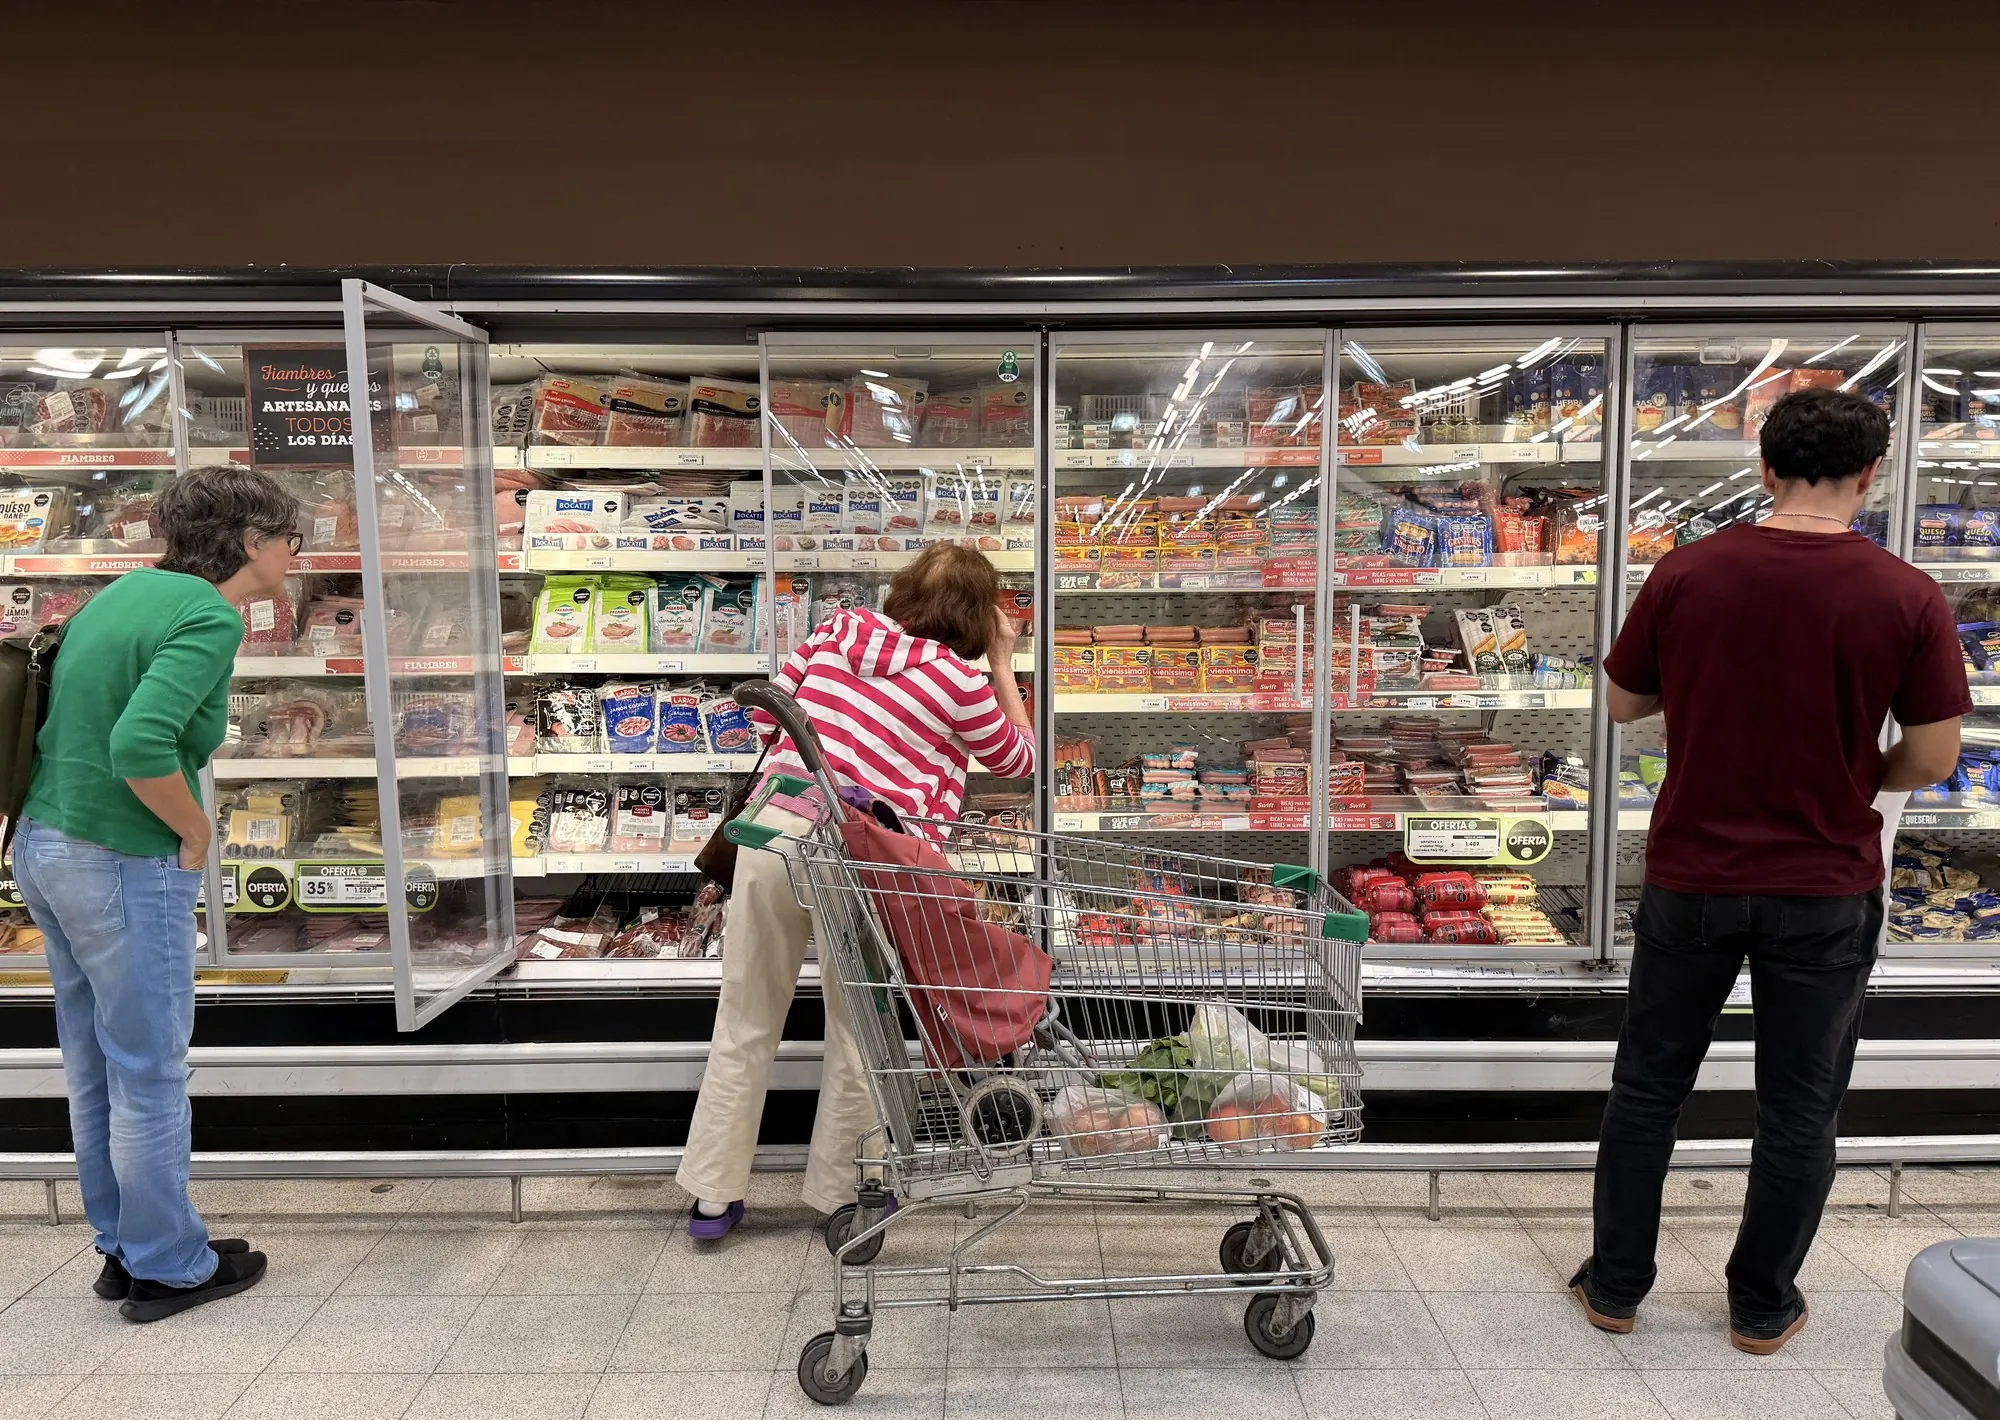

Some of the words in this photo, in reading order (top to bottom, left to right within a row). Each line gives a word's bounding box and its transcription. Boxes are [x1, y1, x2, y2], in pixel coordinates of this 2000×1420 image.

[261, 364, 336, 381] Fiambres
[305, 382, 318, 399] y
[321, 381, 382, 399] ques
[288, 435, 317, 446] LOS
[60, 455, 115, 463] FIAMBRES
[559, 502, 590, 511] BOCATTI
[811, 504, 838, 512] BOCATTI
[736, 511, 764, 519] BOCATTI
[773, 512, 800, 520] BOCATTI
[1919, 528, 1946, 536] QUESO
[535, 539, 562, 547] BOCATTI
[619, 539, 644, 548] BOCATTI
[702, 540, 728, 548] BOCATTI
[743, 540, 766, 548] BOCATT
[826, 541, 850, 549] BOCATTI
[90, 561, 144, 569] FIAMBRES
[391, 559, 445, 567] FIAMBRES
[404, 661, 458, 670] FIAMBRES
[1102, 666, 1145, 675] vienissima!
[1152, 667, 1195, 677] vienissima!
[1210, 666, 1254, 675] vienissima!
[616, 688, 636, 698] LARIO
[673, 696, 695, 704] LARIO
[1257, 801, 1275, 809] Swift
[1905, 814, 1937, 825] QUESERÍA
[1430, 821, 1468, 830] OFERTA
[1508, 836, 1548, 846] OFERTA
[320, 866, 358, 877] OFERTA
[248, 882, 288, 893] OFERTA
[306, 881, 326, 895] 35
[405, 882, 436, 893] OFERTA
